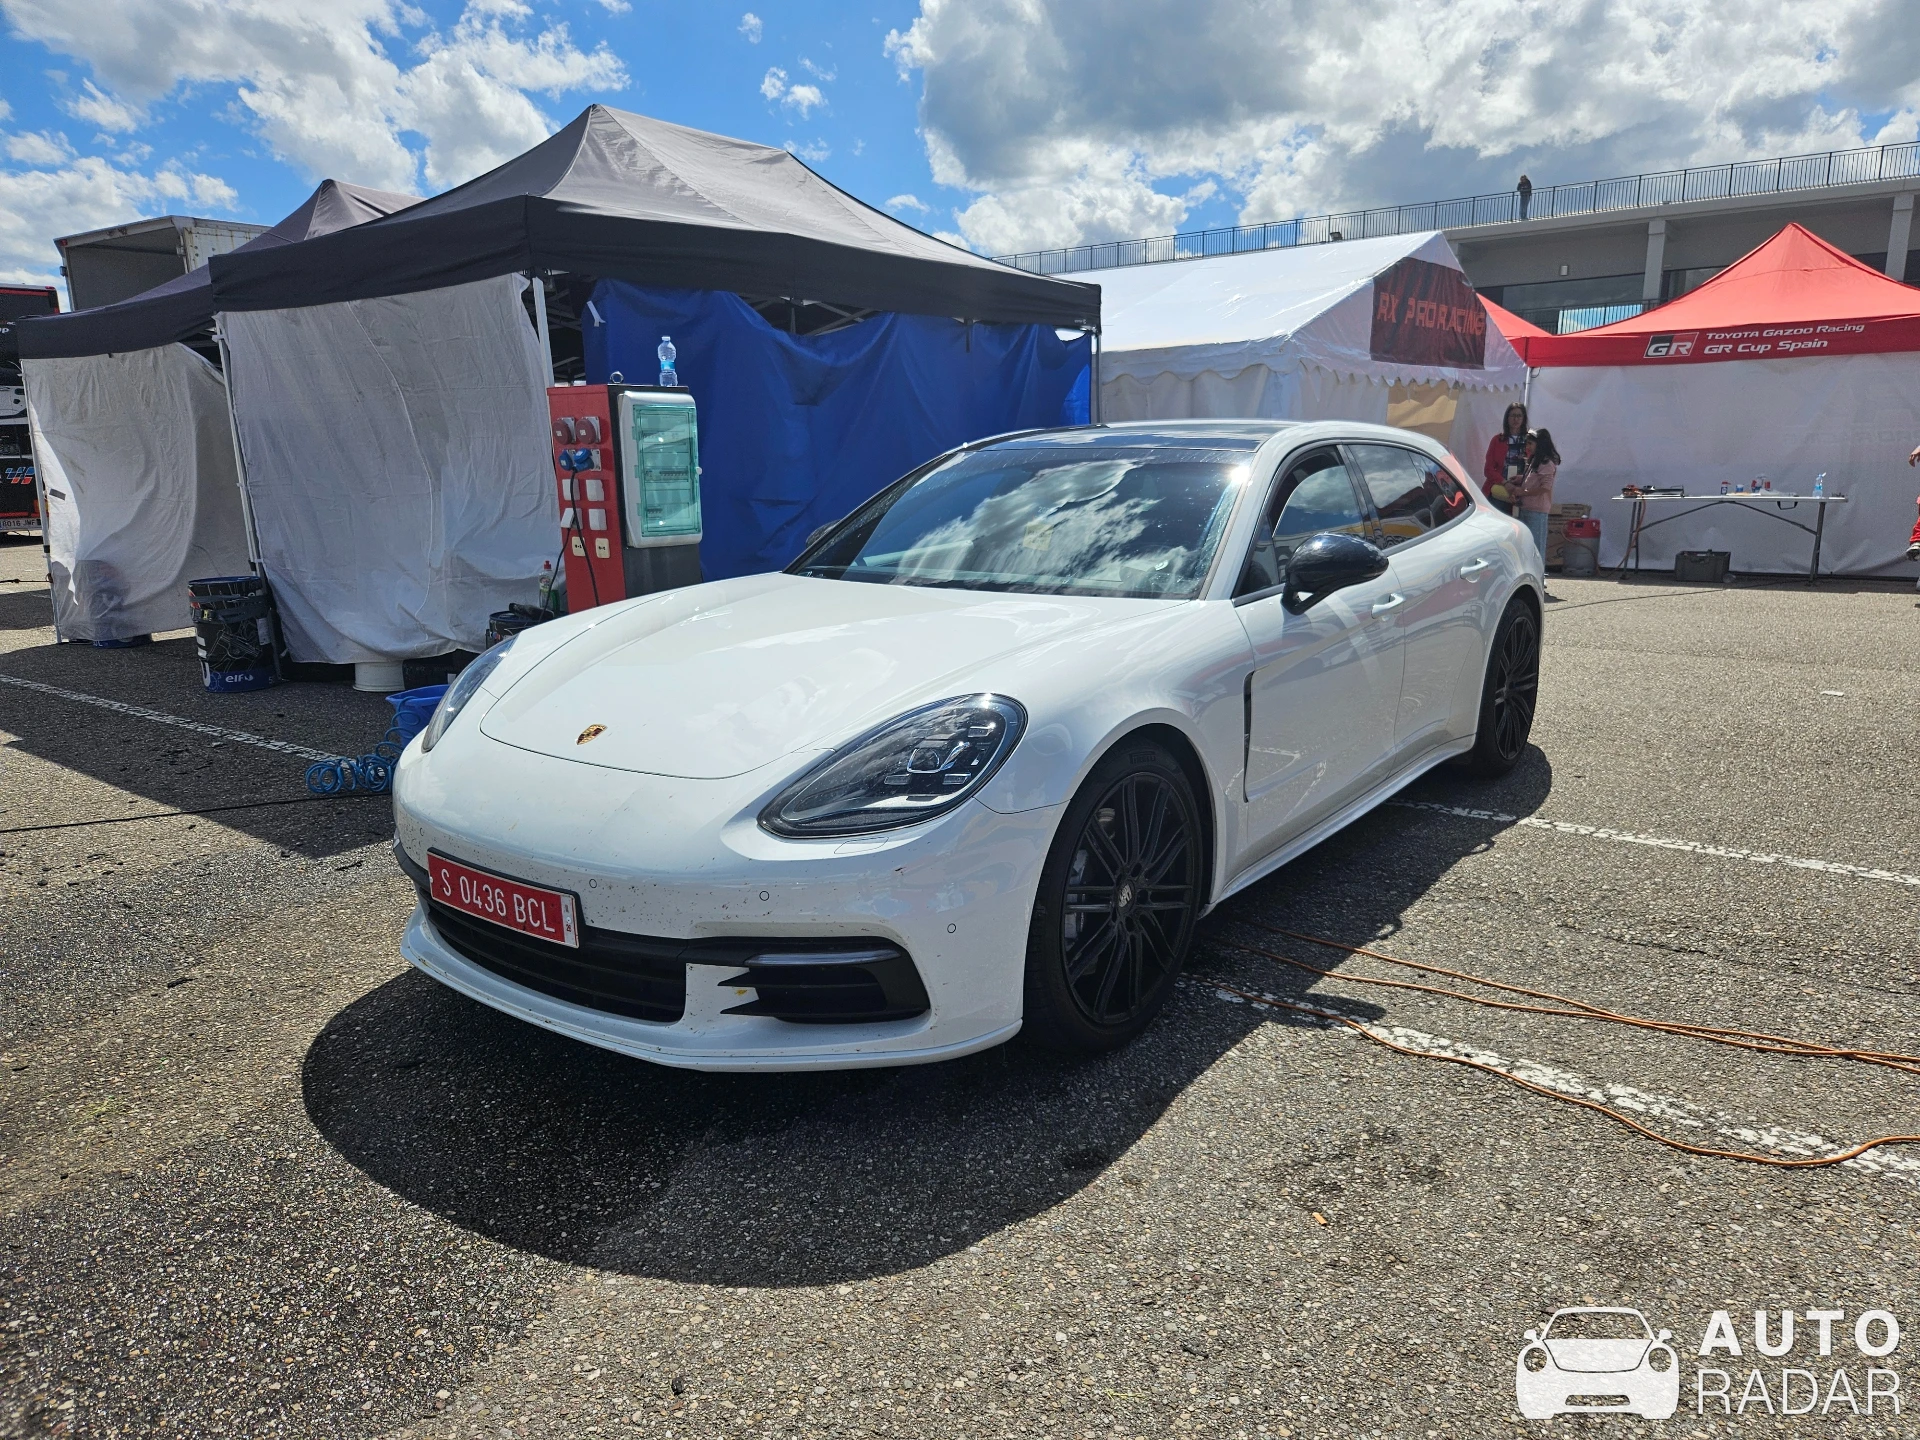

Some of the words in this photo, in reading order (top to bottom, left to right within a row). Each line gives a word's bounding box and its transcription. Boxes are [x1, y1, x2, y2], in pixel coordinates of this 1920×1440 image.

[1377, 292, 1399, 323] RX
[1706, 331, 1759, 340] TOYOTA
[1762, 328, 1814, 337] GAZOO
[1816, 323, 1865, 333] Racing
[1647, 341, 1693, 356] GR
[1703, 344, 1733, 354] GR
[1737, 343, 1772, 354] Cup
[1777, 338, 1828, 352] Spain
[225, 673, 245, 683] elf
[441, 868, 452, 897] S
[459, 875, 507, 917] 0436
[513, 893, 556, 933] BCL
